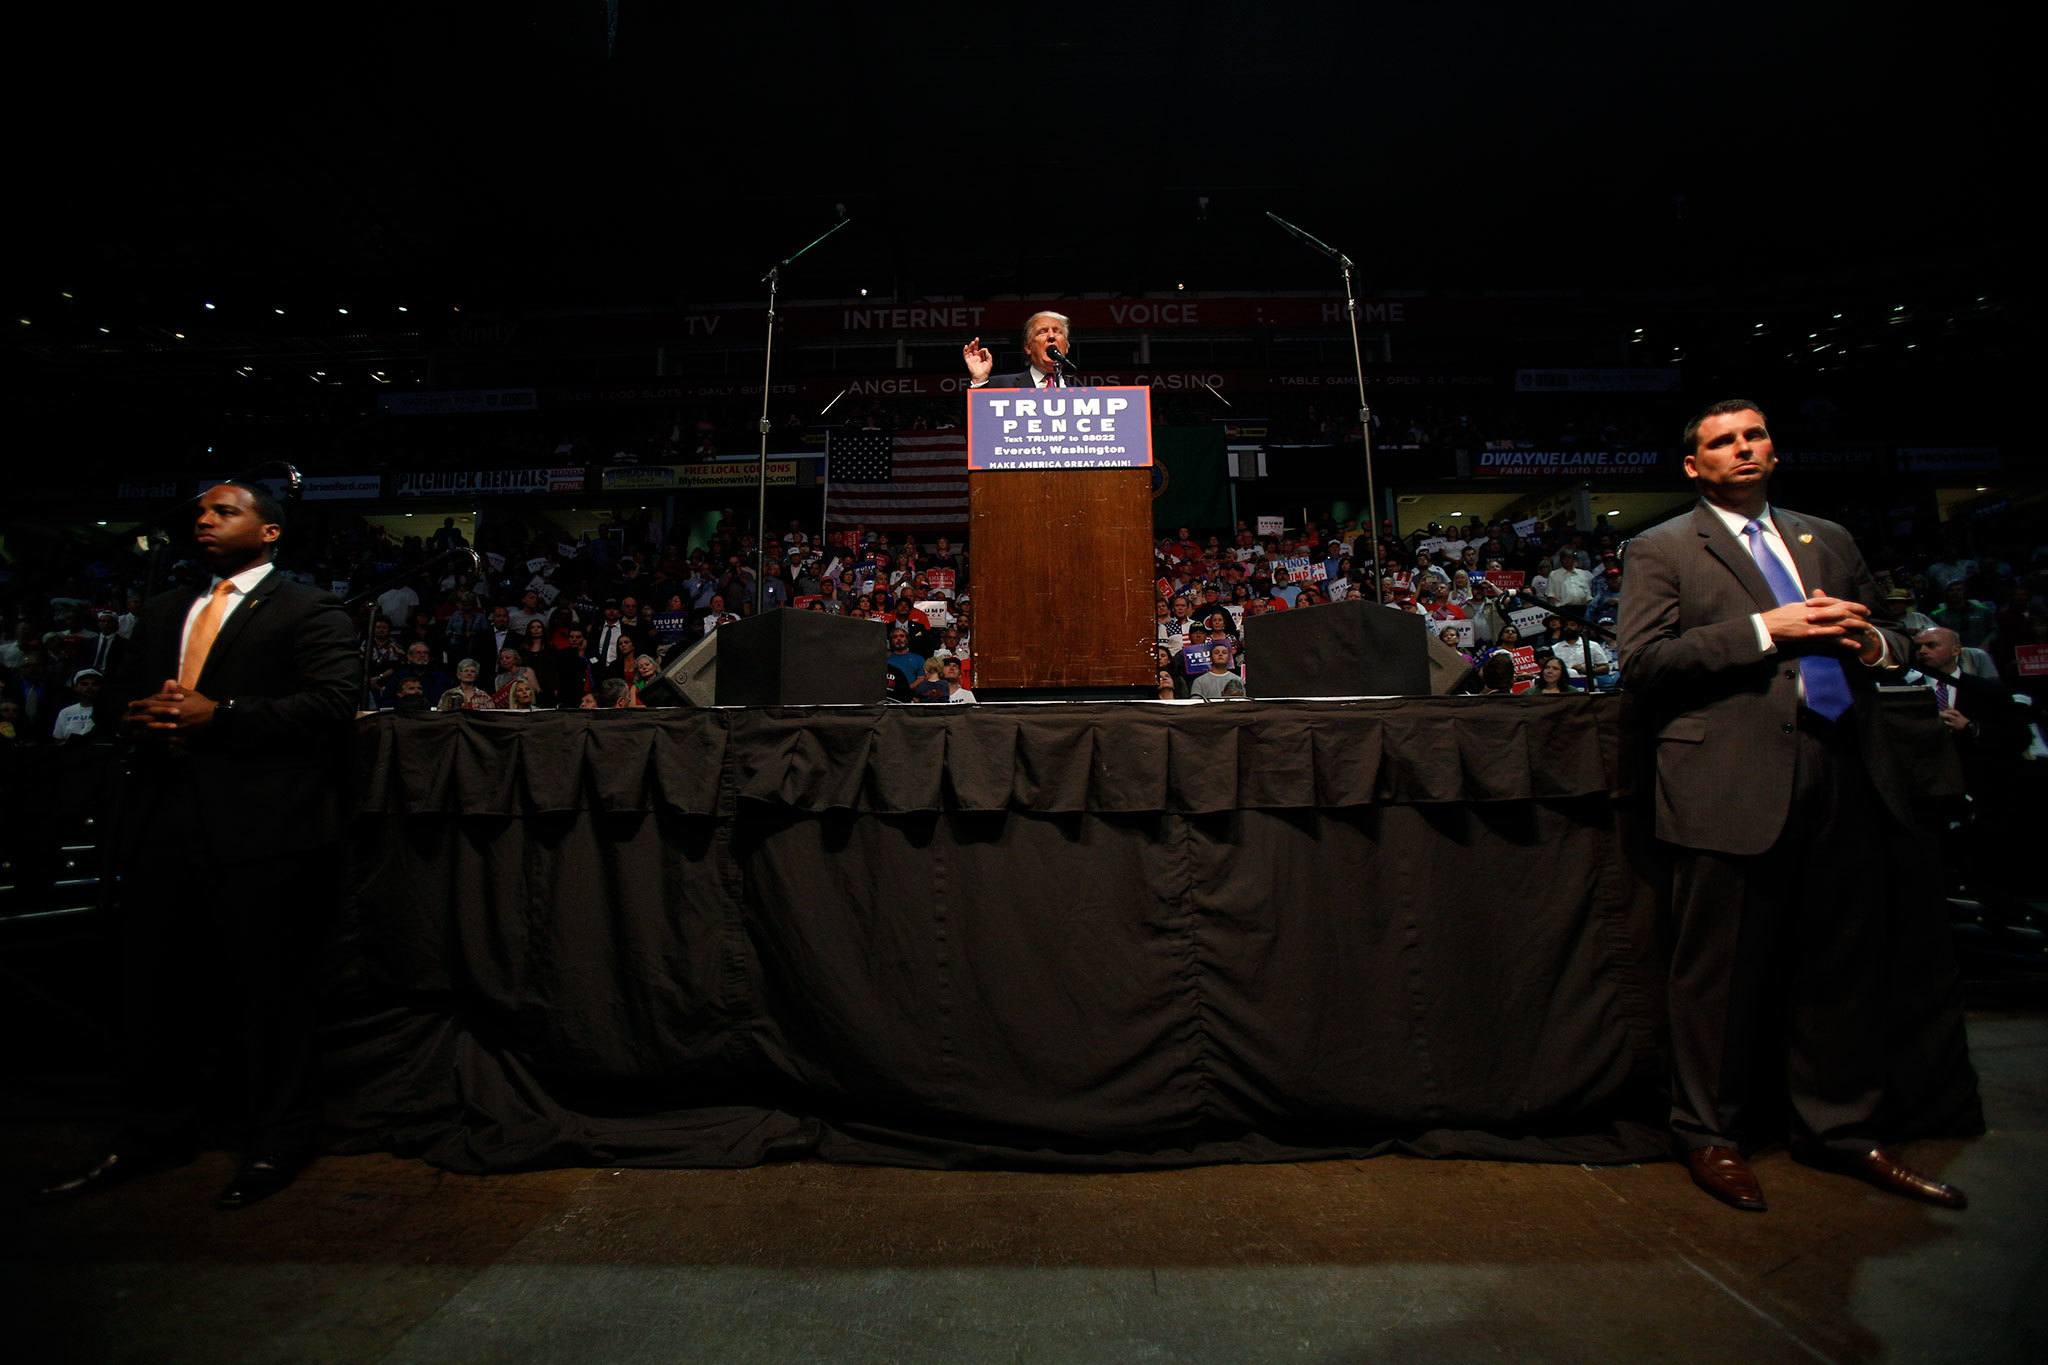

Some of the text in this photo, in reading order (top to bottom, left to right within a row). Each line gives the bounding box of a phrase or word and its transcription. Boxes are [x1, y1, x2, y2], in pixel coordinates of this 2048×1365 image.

[843, 307, 985, 329] INTERNET
[1109, 303, 1200, 324] VOICE
[1320, 302, 1406, 323] HOME
[685, 315, 720, 336] TV
[848, 378, 927, 395] ANGEL
[1133, 373, 1225, 390] CASINO
[1279, 376, 1320, 385] TABLE
[990, 398, 1129, 417] TRUMP
[1003, 418, 1116, 434] PENCE
[1004, 435, 1024, 443] Text
[1026, 435, 1066, 443] TRUMP
[994, 445, 1126, 456] Everett, Washington
[989, 459, 1131, 469] MAKE AMERICA GREAT AGAIN!
[1480, 451, 1659, 466] DWAYNELANE.COM
[684, 465, 709, 475] FREE
[711, 465, 742, 474] LOCAL
[1500, 465, 1645, 475] FAMILY OF AUTO CENTERS
[399, 471, 478, 490] PILCHUCK
[481, 469, 549, 489] RENTALS
[1515, 612, 1550, 625] TRUMP
[1186, 651, 1211, 660] TRU
